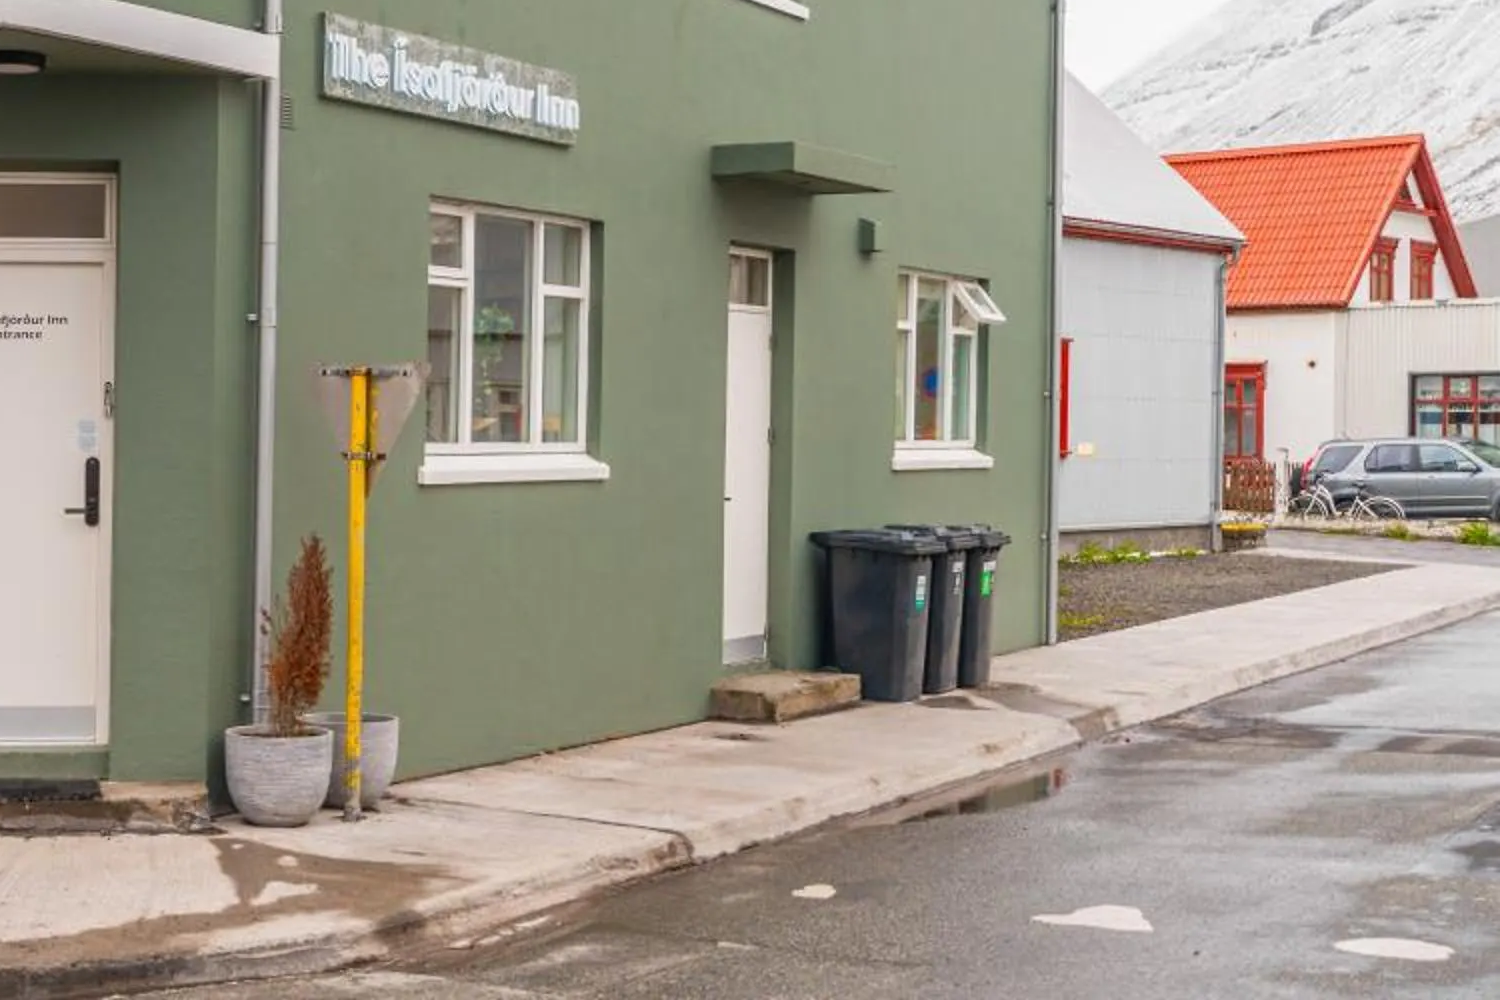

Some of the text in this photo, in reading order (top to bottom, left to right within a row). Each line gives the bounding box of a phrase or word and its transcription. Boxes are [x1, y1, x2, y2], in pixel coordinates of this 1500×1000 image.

[326, 32, 389, 89] The
[536, 83, 580, 130] Inn
[47, 314, 68, 325] Inn
